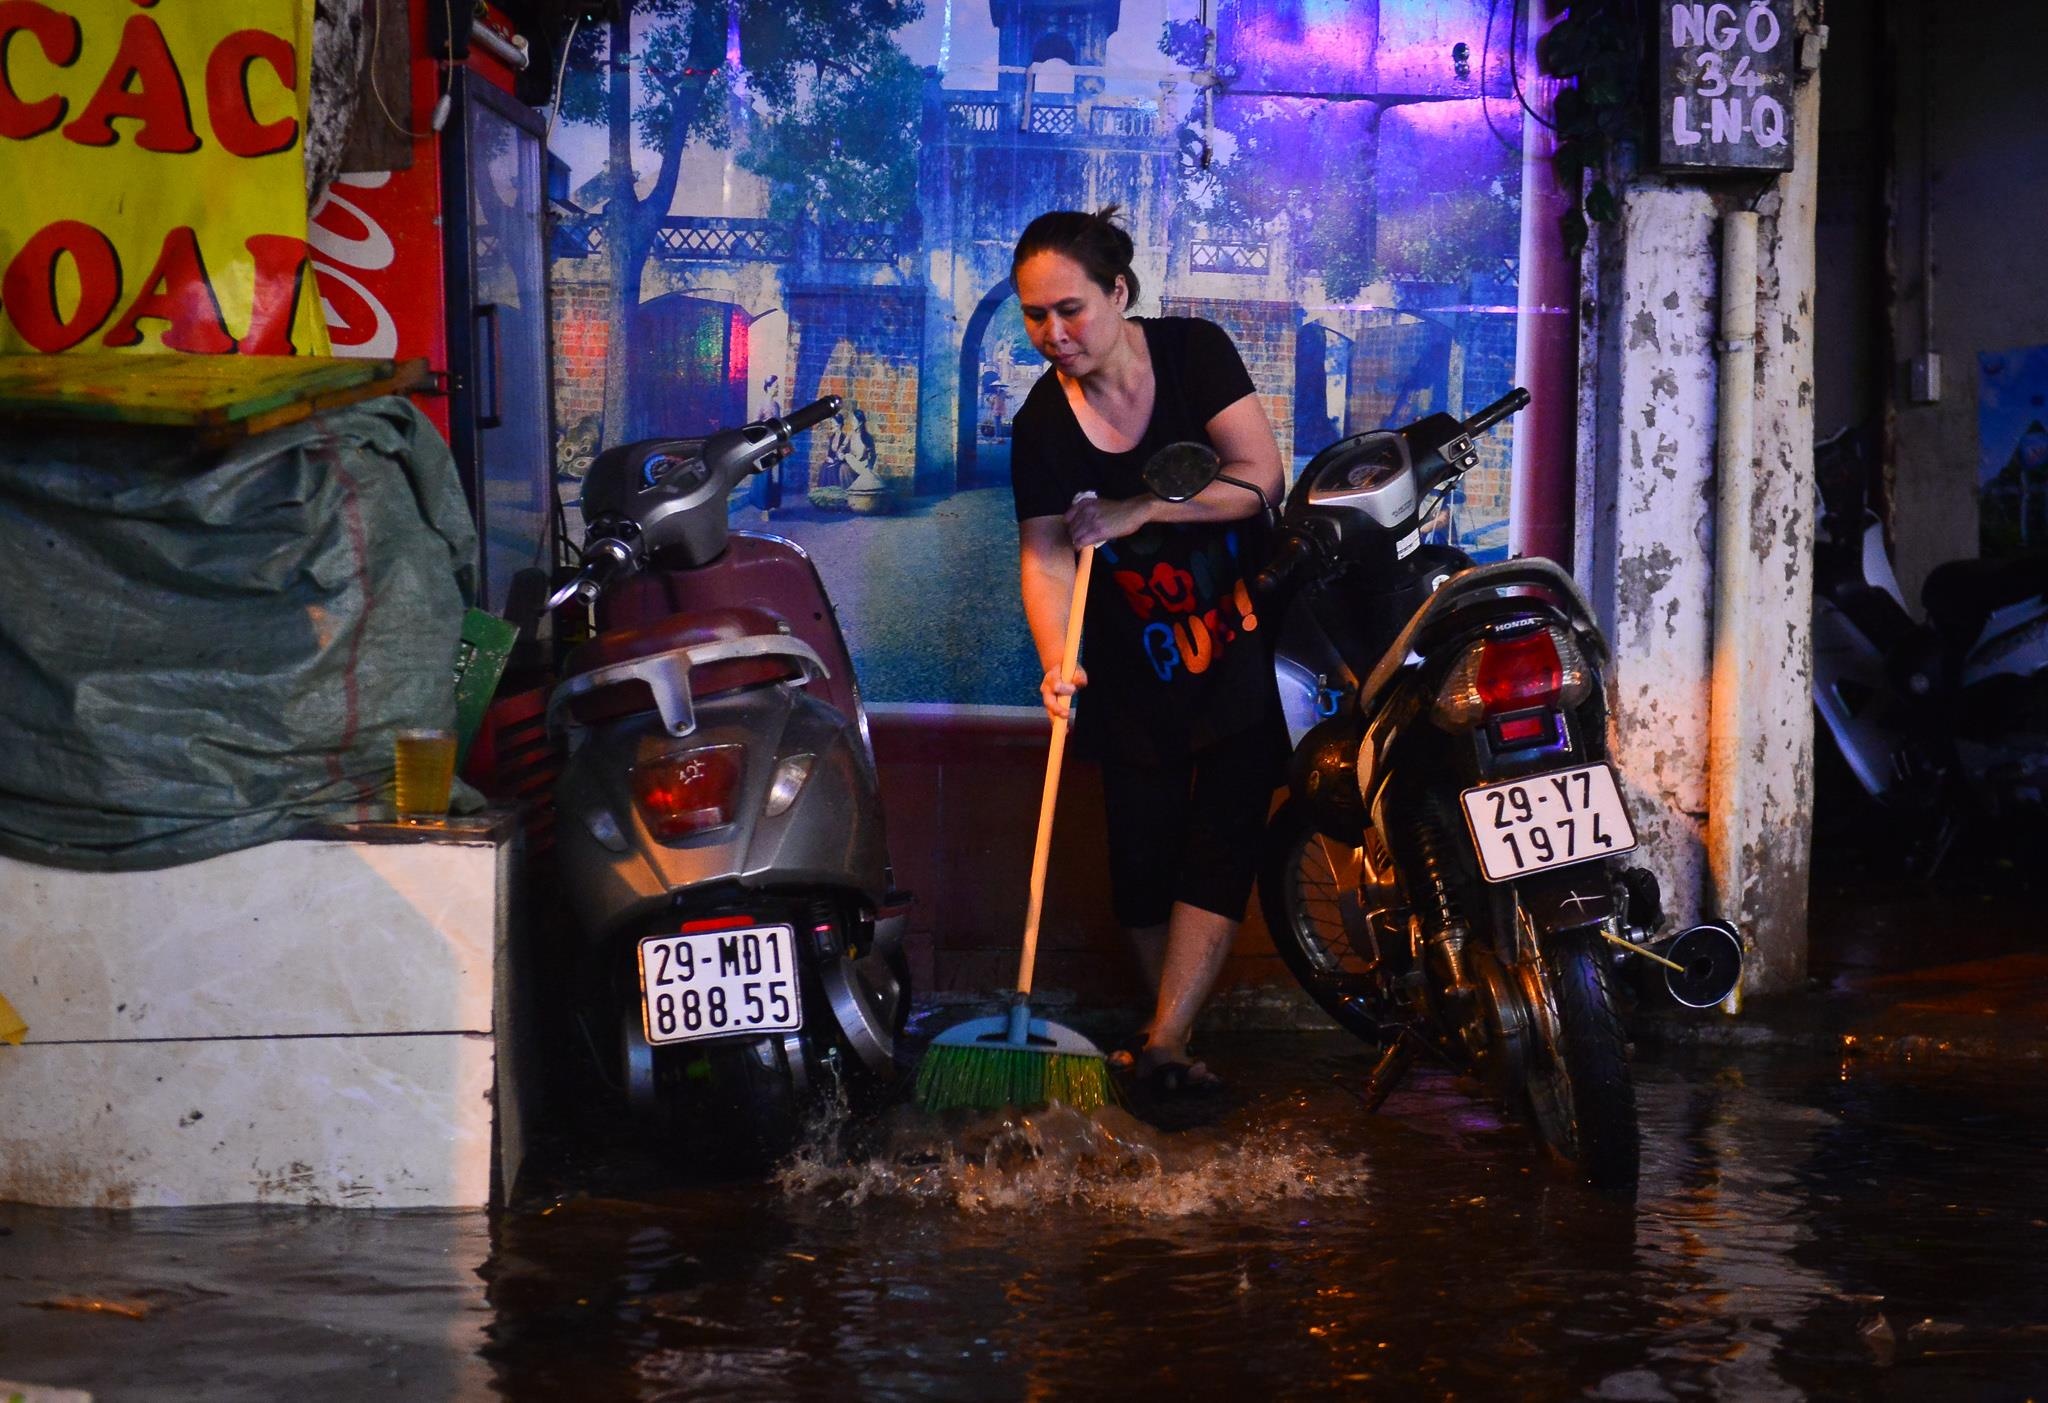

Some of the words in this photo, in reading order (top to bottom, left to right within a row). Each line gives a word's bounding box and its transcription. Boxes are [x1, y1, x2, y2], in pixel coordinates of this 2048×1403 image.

[1696, 52, 1765, 97] 34
[1495, 618, 1535, 632] HONDA
[1486, 771, 1591, 829] 29-Y7
[1502, 812, 1613, 868] 1974
[656, 981, 790, 1035] 888.55
